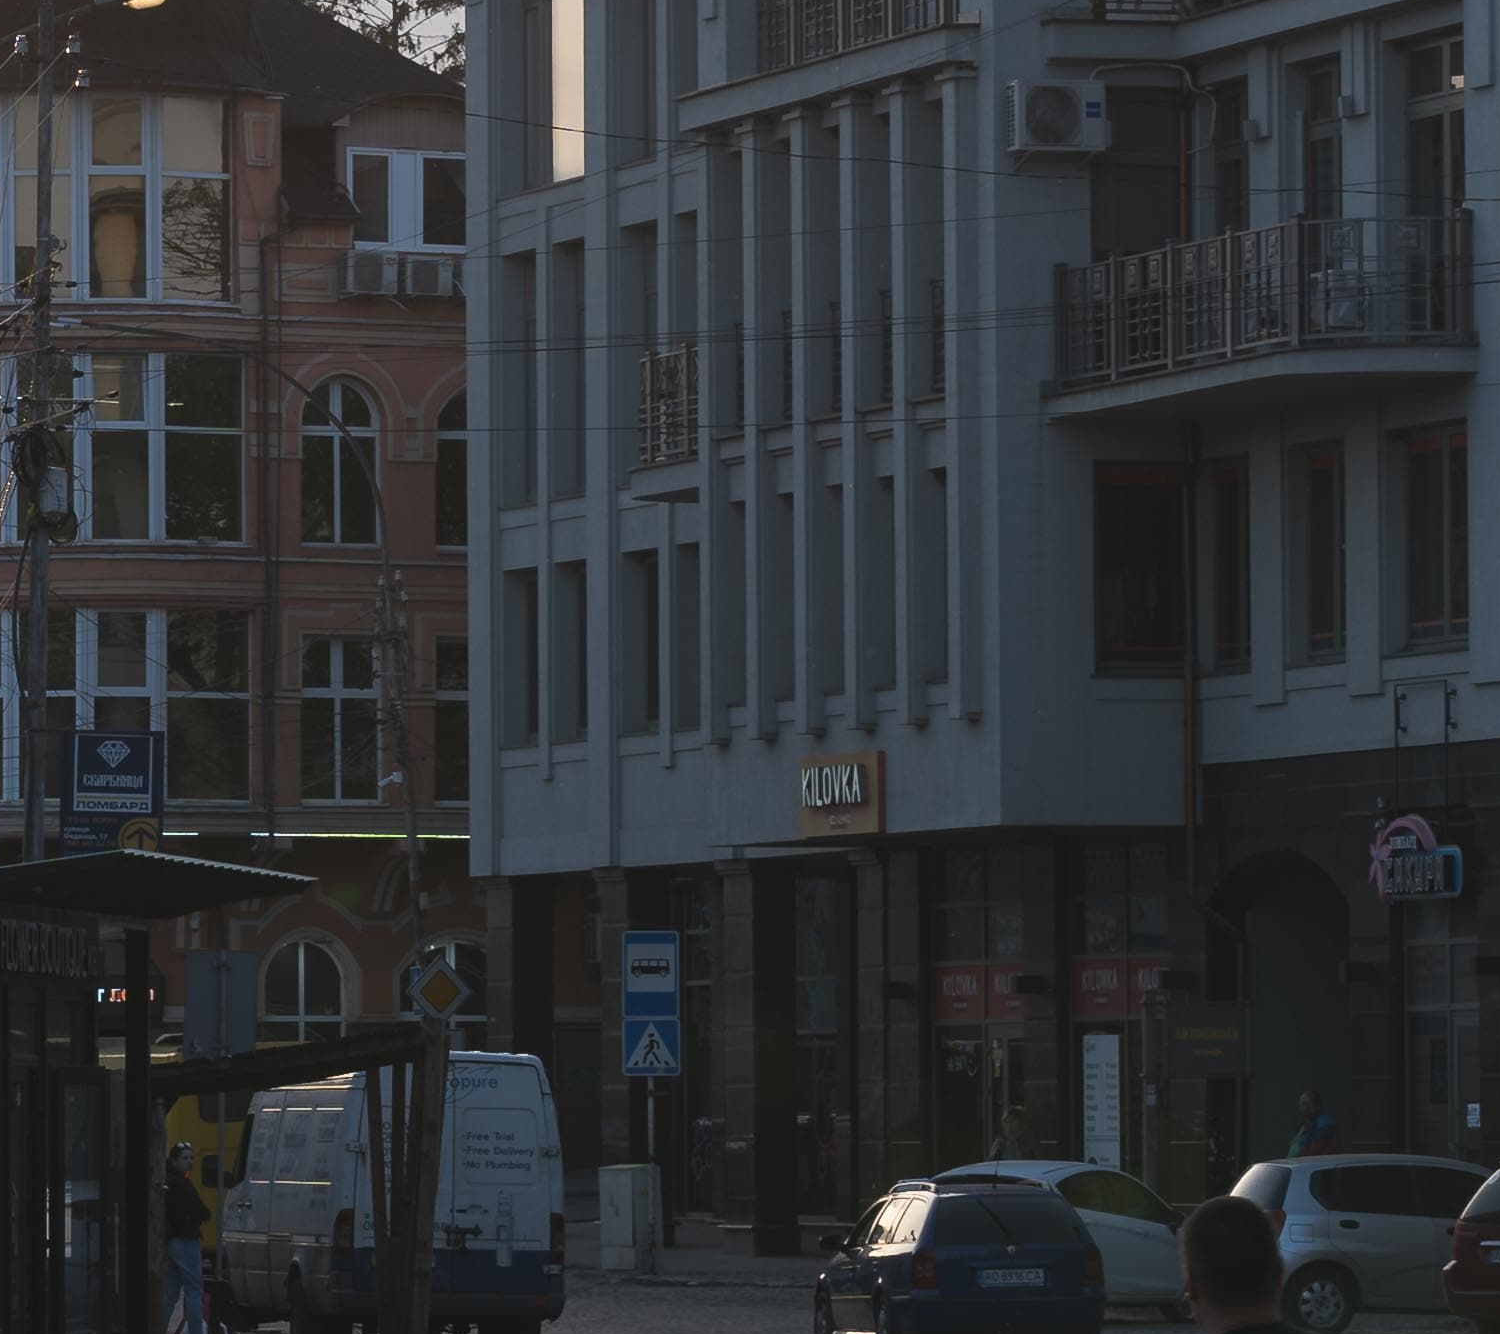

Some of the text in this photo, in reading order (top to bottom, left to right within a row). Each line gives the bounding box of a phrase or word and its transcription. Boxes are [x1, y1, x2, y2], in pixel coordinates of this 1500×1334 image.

[801, 763, 861, 807] KILOVKA
[76, 801, 148, 811] ЛОМБАРД
[494, 1147, 535, 1157] Delivery
[486, 1161, 531, 1171] Plumbing
